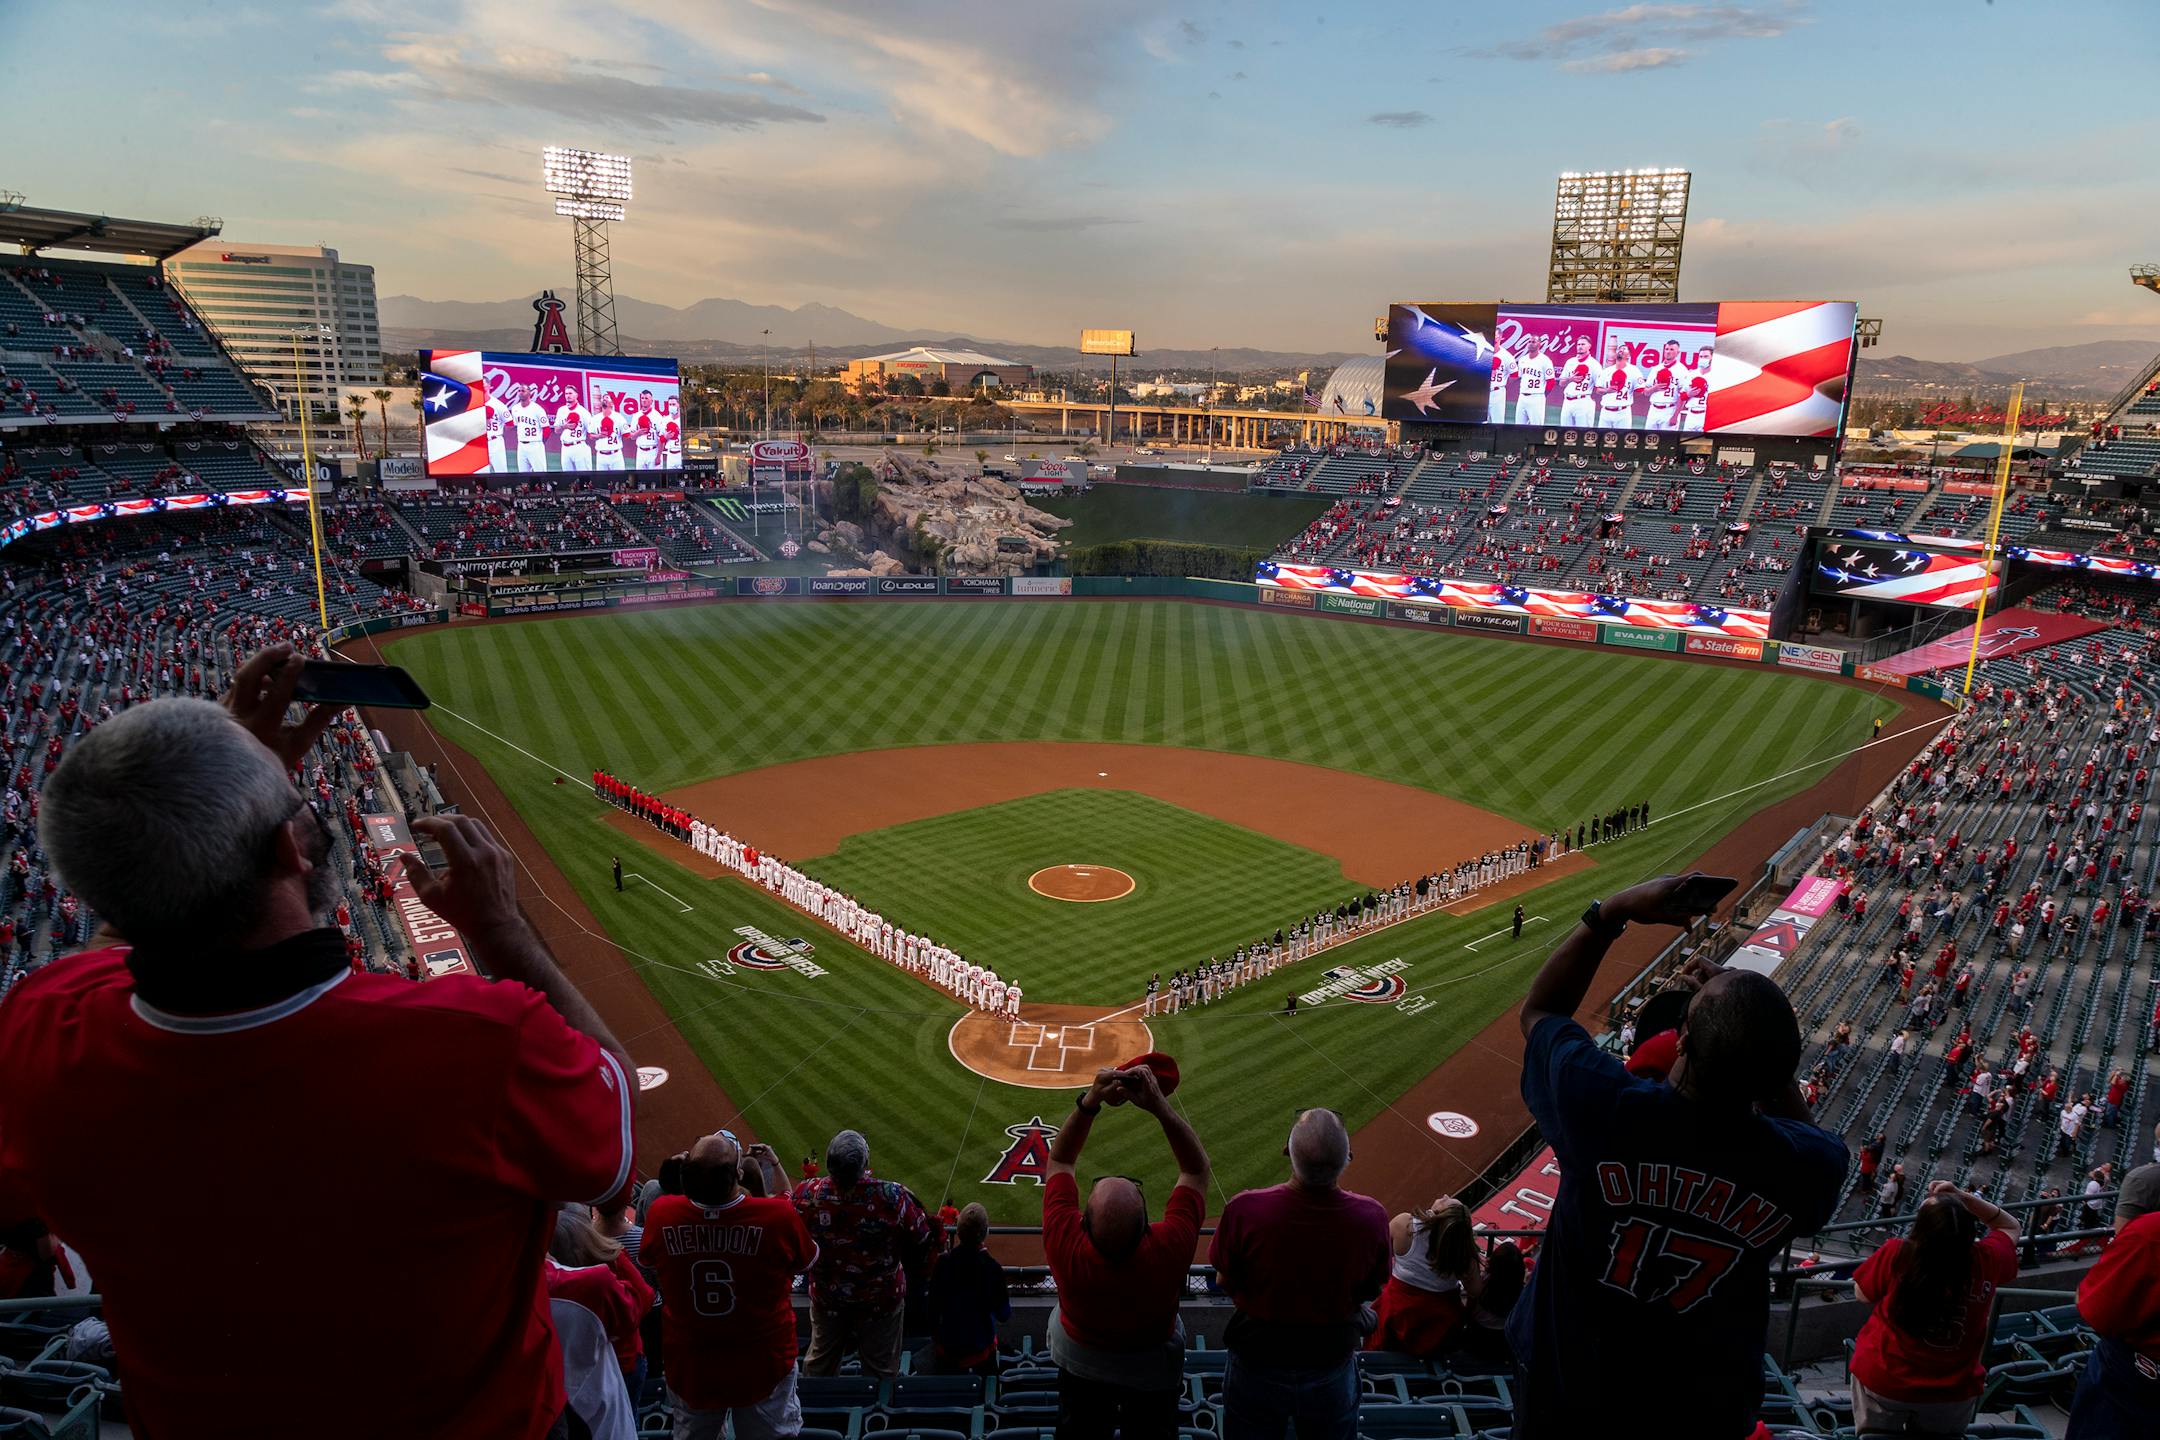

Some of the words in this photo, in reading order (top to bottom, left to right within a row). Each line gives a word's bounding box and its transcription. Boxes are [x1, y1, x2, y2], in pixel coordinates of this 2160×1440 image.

[1528, 379, 1541, 389] 32
[1616, 391, 1629, 401] 24
[1664, 387, 1675, 397] 21
[524, 427, 537, 437] 32
[607, 436, 618, 445] 24
[763, 447, 799, 456] Yakult
[385, 462, 420, 476] Modelo
[1040, 459, 1068, 471] Coors
[812, 581, 866, 592] loanDepot
[896, 582, 936, 590] LEXUS
[1017, 584, 1057, 593] turmeric
[1275, 592, 1311, 602] PECHANGA
[1337, 598, 1375, 610] National
[402, 614, 426, 625] Modelo
[1458, 613, 1481, 623] NITTO
[1781, 645, 1840, 663] NEXGEN
[733, 925, 794, 961] OPENING
[781, 954, 829, 979] WEEK
[1299, 974, 1372, 1006] OPENING
[1362, 957, 1414, 980] WEEK
[1597, 1161, 1793, 1248] OHTANI
[662, 1225, 763, 1256] RENDON
[1598, 1216, 1745, 1314] 17
[690, 1260, 736, 1317] 6
